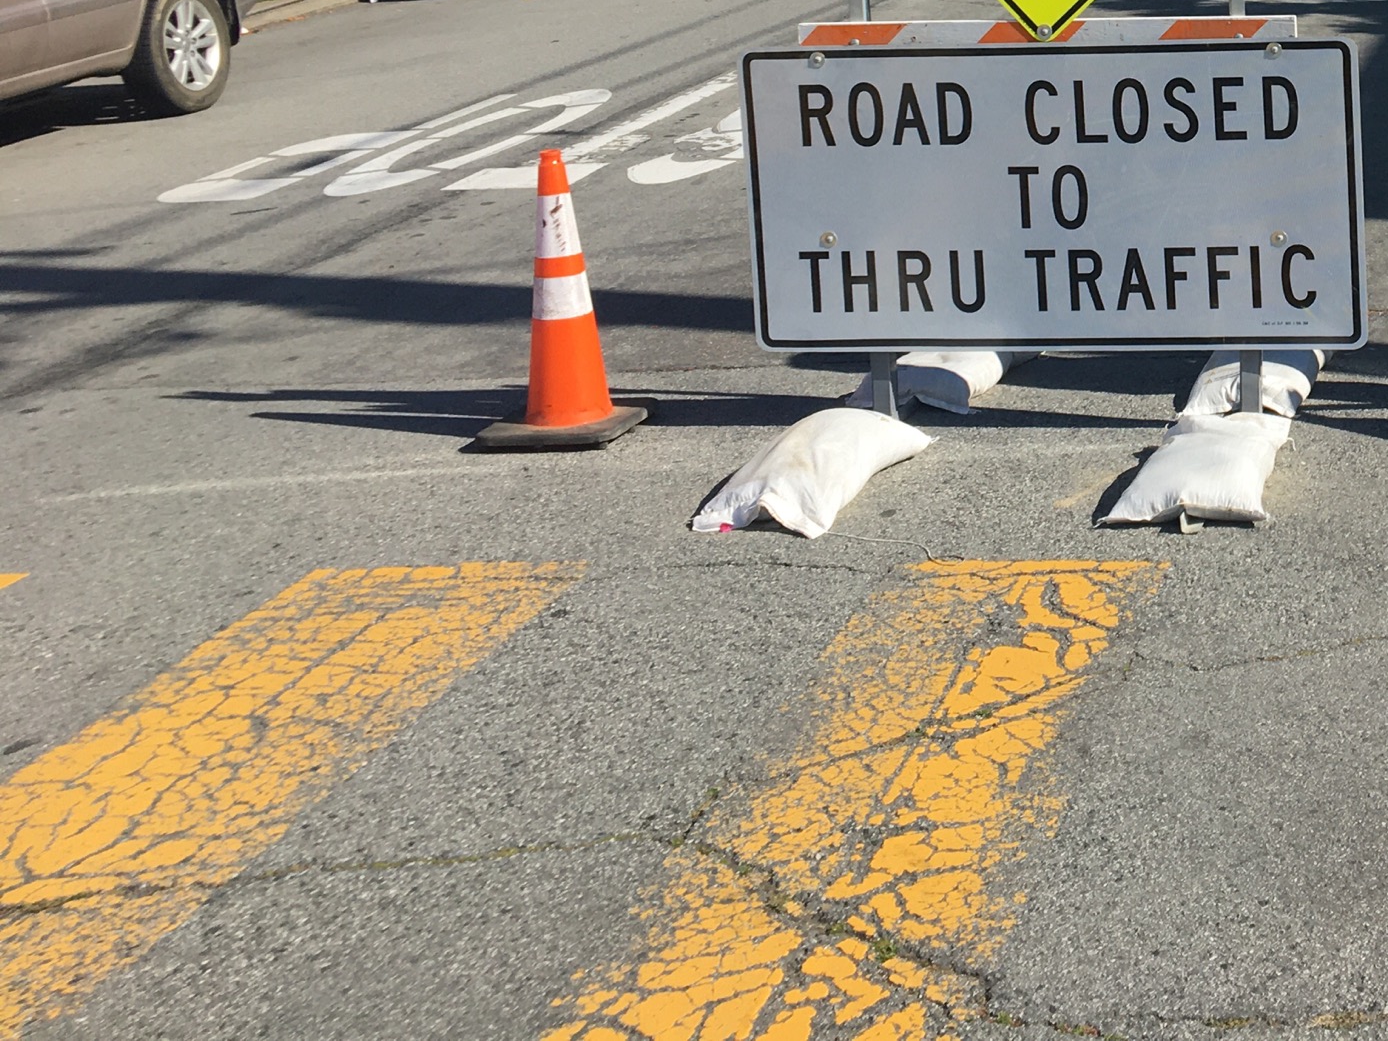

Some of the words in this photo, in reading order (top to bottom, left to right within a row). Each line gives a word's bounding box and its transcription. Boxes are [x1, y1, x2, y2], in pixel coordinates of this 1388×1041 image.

[798, 81, 973, 147] ROAD
[1024, 75, 1298, 145] CLOSED
[1007, 164, 1089, 230] TO
[798, 248, 986, 314] THRU
[1024, 244, 1318, 312] TRAFFIC
